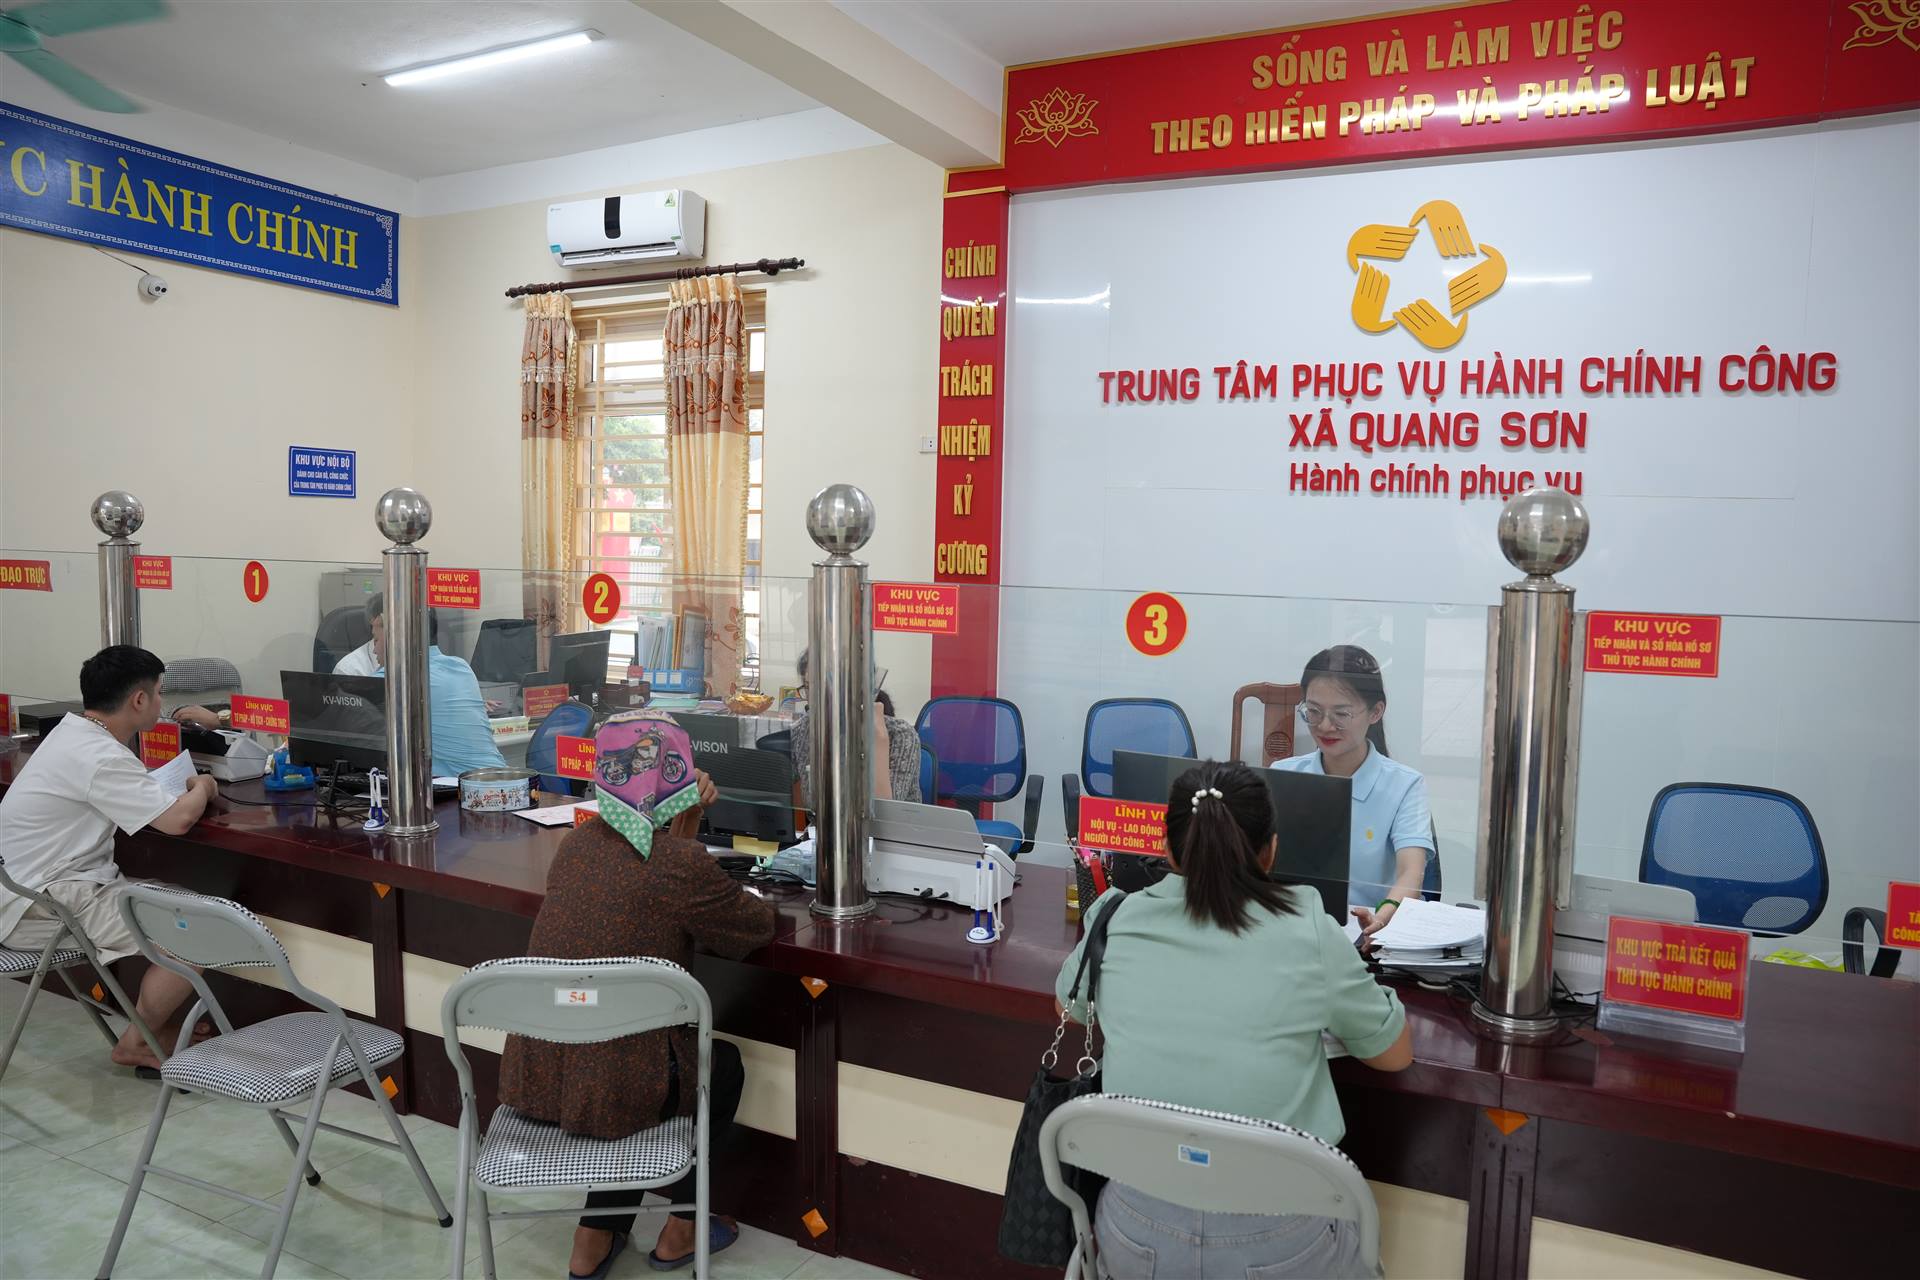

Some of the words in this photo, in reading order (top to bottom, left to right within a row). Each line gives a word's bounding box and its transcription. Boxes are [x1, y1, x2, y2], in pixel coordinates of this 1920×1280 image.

[1252, 34, 1347, 89] SỐNG
[1366, 29, 1409, 76] VÀ
[1426, 20, 1510, 70] LÀM
[1530, 4, 1623, 62] VIỆC
[1150, 114, 1233, 154] THEO
[1245, 91, 1327, 145] HIẾN
[1339, 85, 1435, 136] PHÁP
[1456, 76, 1502, 126] VÀ
[1518, 65, 1625, 121] PHÁP
[1645, 51, 1756, 109] LUẬT
[0, 141, 48, 197] C
[66, 157, 213, 236] HÀNH
[227, 205, 358, 269] CHÍNH
[945, 240, 997, 278] CHÍNH
[943, 296, 995, 341] QUYỀN
[941, 359, 993, 397] TRÁCH
[1098, 368, 1200, 403] TRUNG
[1213, 360, 1279, 399] TÂM
[1292, 362, 1383, 405] PHỤC
[1398, 361, 1446, 403] VỤ
[1460, 351, 1563, 394] HÀNH
[1580, 348, 1702, 393] CHÍNH
[1719, 344, 1837, 392] CÔNG
[941, 418, 991, 462] NHIỆM
[1288, 407, 1338, 447] XÃ
[1350, 411, 1479, 453] QUANG
[1500, 410, 1588, 448] SƠN
[295, 454, 310, 466] KHU
[311, 454, 326, 468] VỰC
[327, 455, 339, 469] NỘI
[340, 456, 350, 470] BỘ
[953, 474, 973, 516] KỶ
[1290, 462, 1359, 492] Hành
[1370, 463, 1449, 493] chính
[1460, 464, 1535, 501] phục
[937, 543, 988, 576] CƯƠNG
[24, 566, 46, 588] TRỰC
[252, 569, 259, 595] 1
[438, 573, 452, 582] KHU
[453, 573, 469, 584] VỰC
[593, 581, 609, 614] 2
[890, 589, 912, 599] KHU
[916, 590, 940, 603] VỰC
[1144, 604, 1168, 646] 3
[1614, 619, 1648, 633] KHU
[1654, 620, 1691, 637] VỰC
[1594, 635, 1610, 648] TIẾP
[1613, 638, 1637, 652] NHẬN
[1639, 638, 1650, 651] VÀ
[1652, 637, 1664, 651] SỐ
[1685, 638, 1697, 653] HỒ
[1699, 642, 1712, 653] SƠ
[1602, 652, 1620, 665] THỦ
[1622, 655, 1640, 668] TỤC
[1642, 654, 1669, 667] HÀNH
[1671, 656, 1701, 669] CHÍNH
[322, 695, 362, 707] KV-VISON
[690, 740, 728, 754] -VISON
[1090, 818, 1104, 831] NỘI
[1106, 821, 1117, 832] VỤ
[1124, 823, 1138, 834] LAO
[1140, 823, 1163, 837] ĐỘNG
[1115, 804, 1146, 820] LĨNH
[1084, 832, 1108, 844] NGƯỜI
[1110, 834, 1121, 845] CÓ
[1123, 836, 1144, 848] CÔNG
[1616, 937, 1638, 956] KHU
[1641, 940, 1663, 962] VỰC
[1666, 940, 1686, 963] TRẢ
[1689, 942, 1711, 966] KẾT
[1713, 946, 1736, 970] QUẢ
[569, 991, 586, 1003] 54
[1616, 963, 1637, 986] THỦ
[1640, 970, 1660, 992] TỤC
[1663, 971, 1694, 995] HÀNH
[1696, 977, 1732, 1000] CHÍNH
